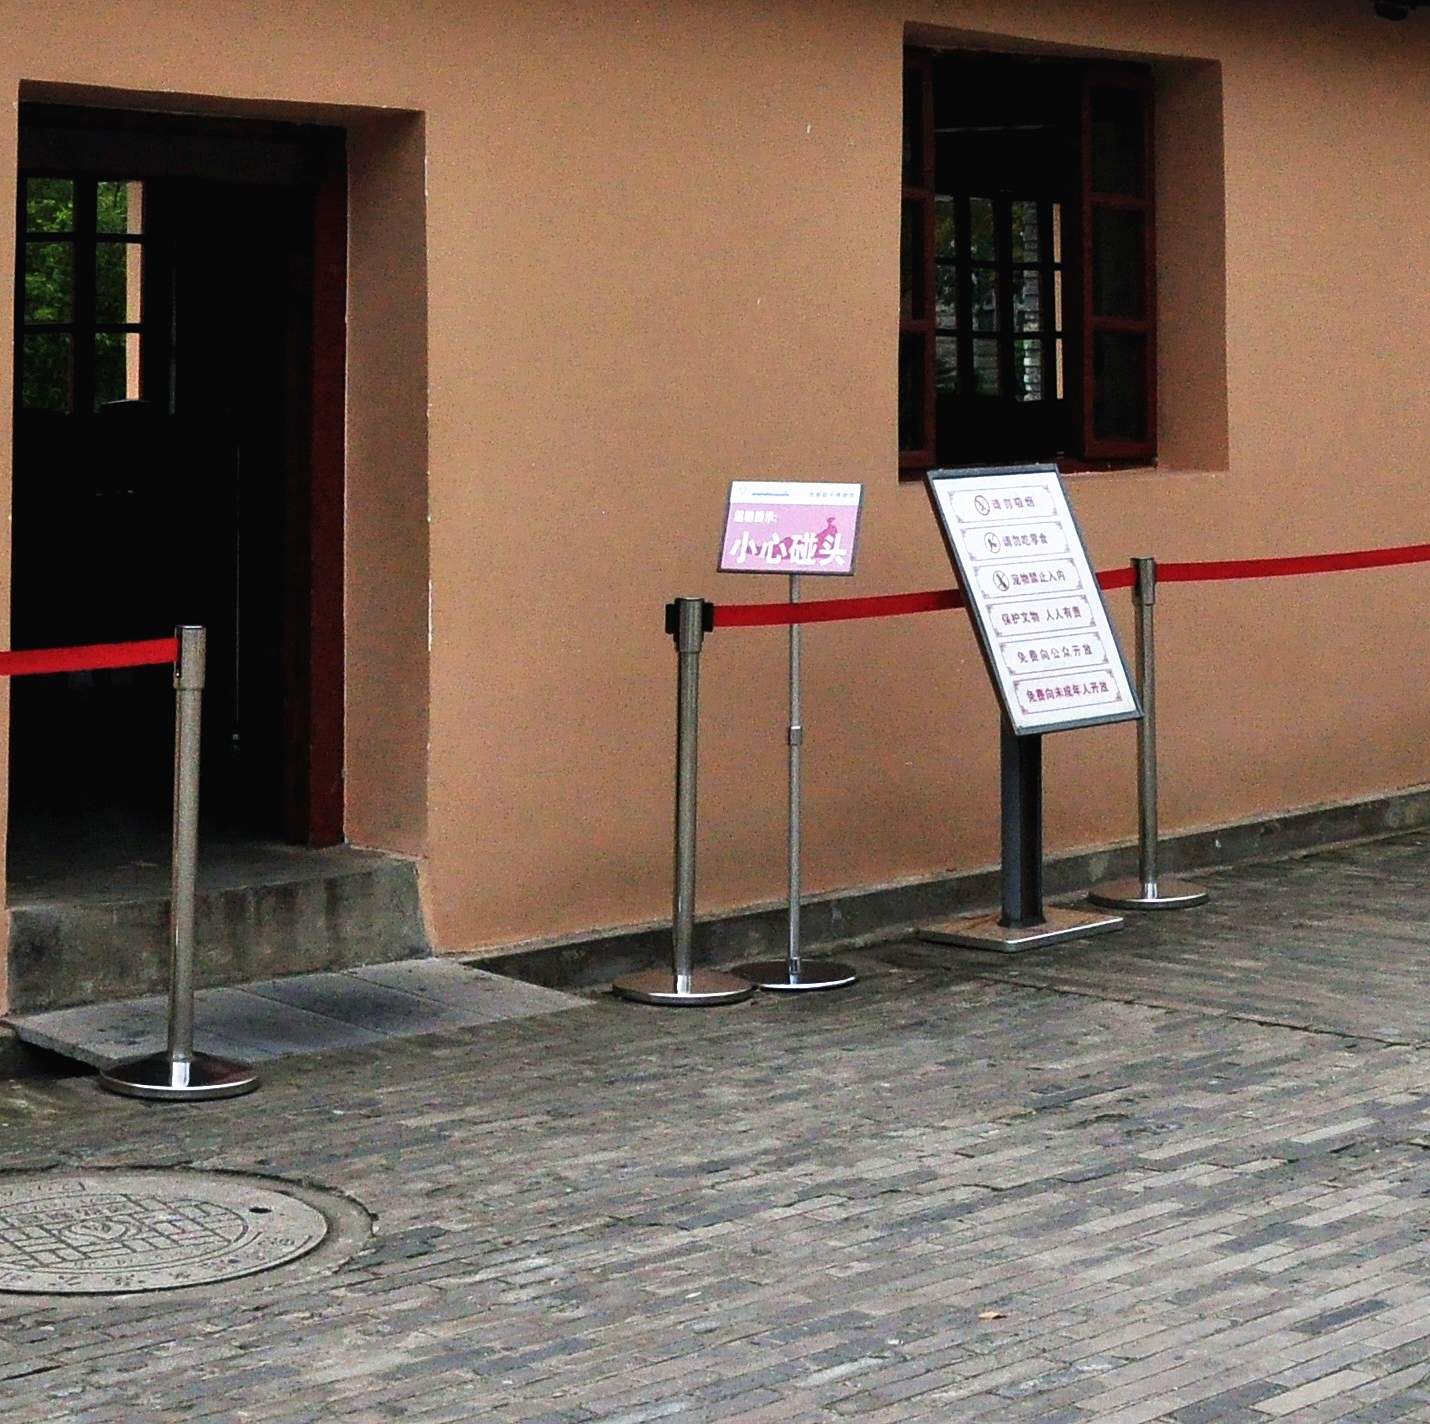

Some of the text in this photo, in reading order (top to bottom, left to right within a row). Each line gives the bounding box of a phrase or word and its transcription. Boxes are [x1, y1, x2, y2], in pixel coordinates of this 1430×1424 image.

[729, 530, 848, 566] 小心碰头
[1002, 532, 1049, 547] 请勿吃零食
[1001, 605, 1082, 626] 保护文物 人人有责
[1017, 644, 1093, 664] 免费向公众开放
[1026, 680, 1109, 704] 免费向未成年人开放
